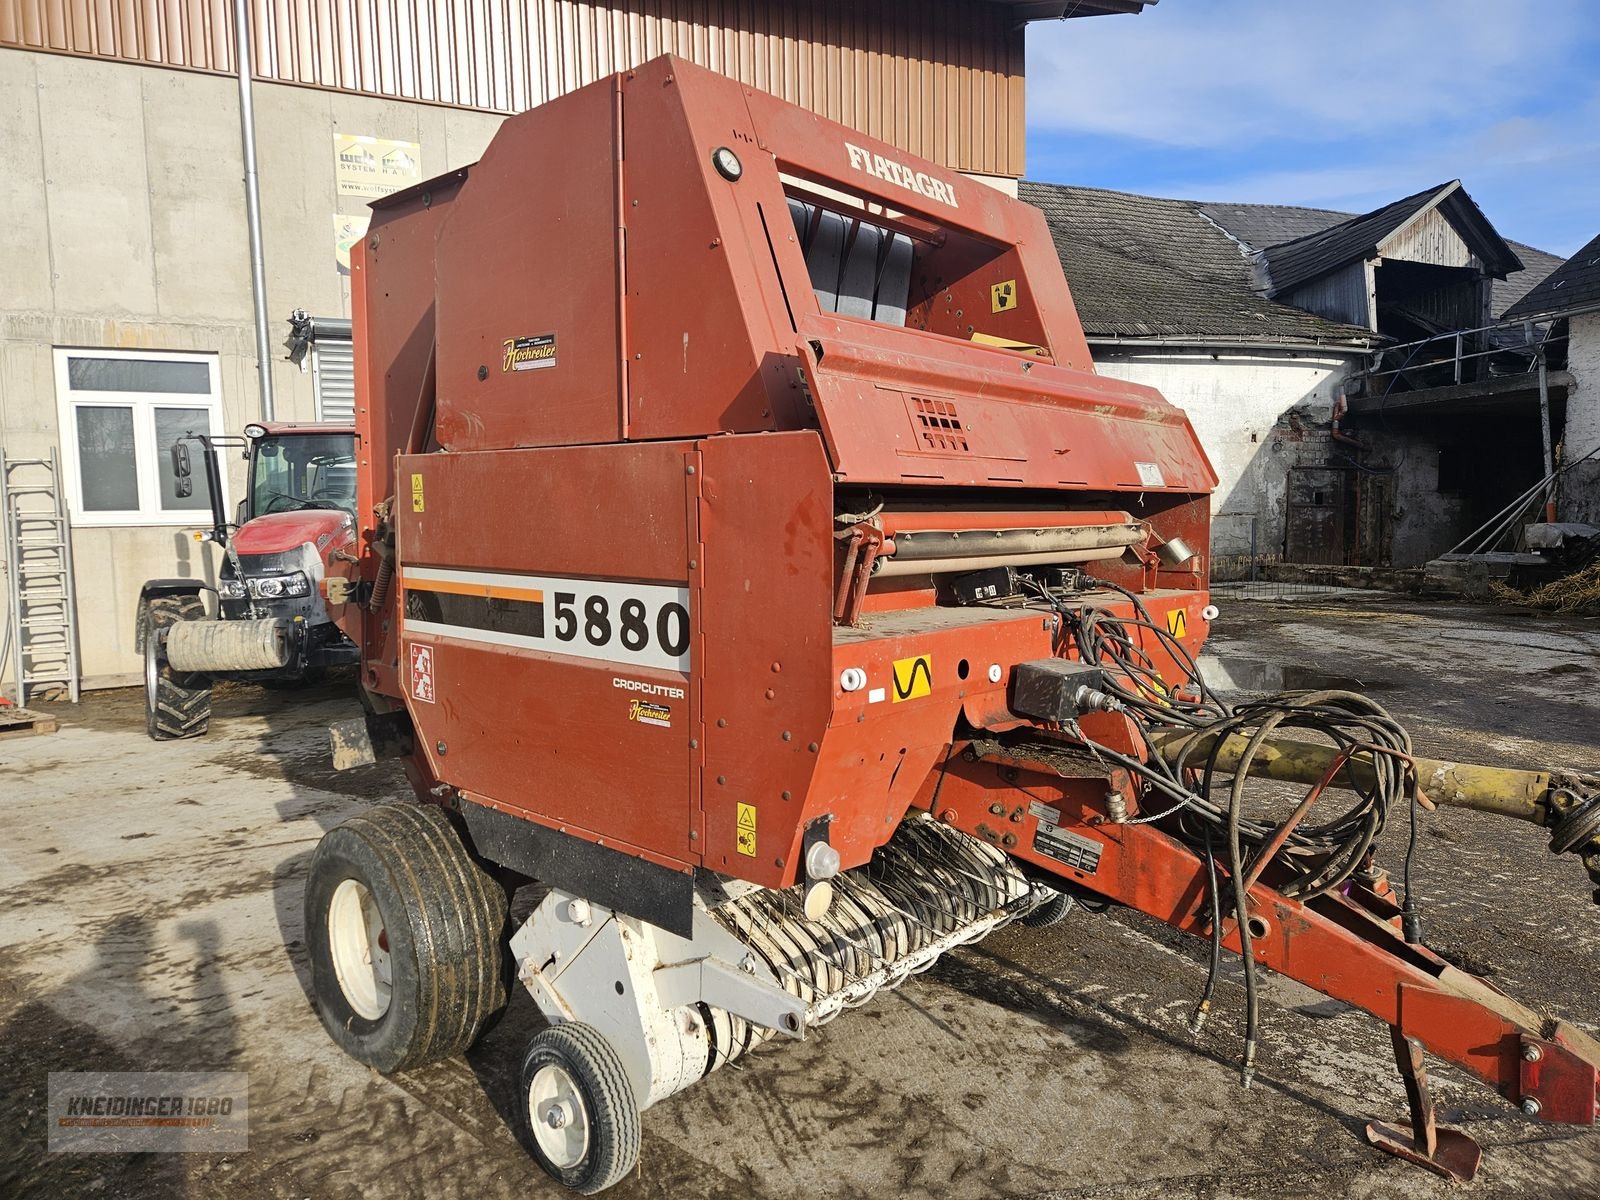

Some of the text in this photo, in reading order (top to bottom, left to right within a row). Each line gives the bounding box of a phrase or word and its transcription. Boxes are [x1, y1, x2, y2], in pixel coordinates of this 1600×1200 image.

[340, 164, 375, 173] SYSTEM
[844, 142, 959, 208] FIATAGRI
[503, 337, 556, 372] Hochreiter
[554, 591, 690, 657] 5880
[612, 677, 684, 700] CROPCUTTER
